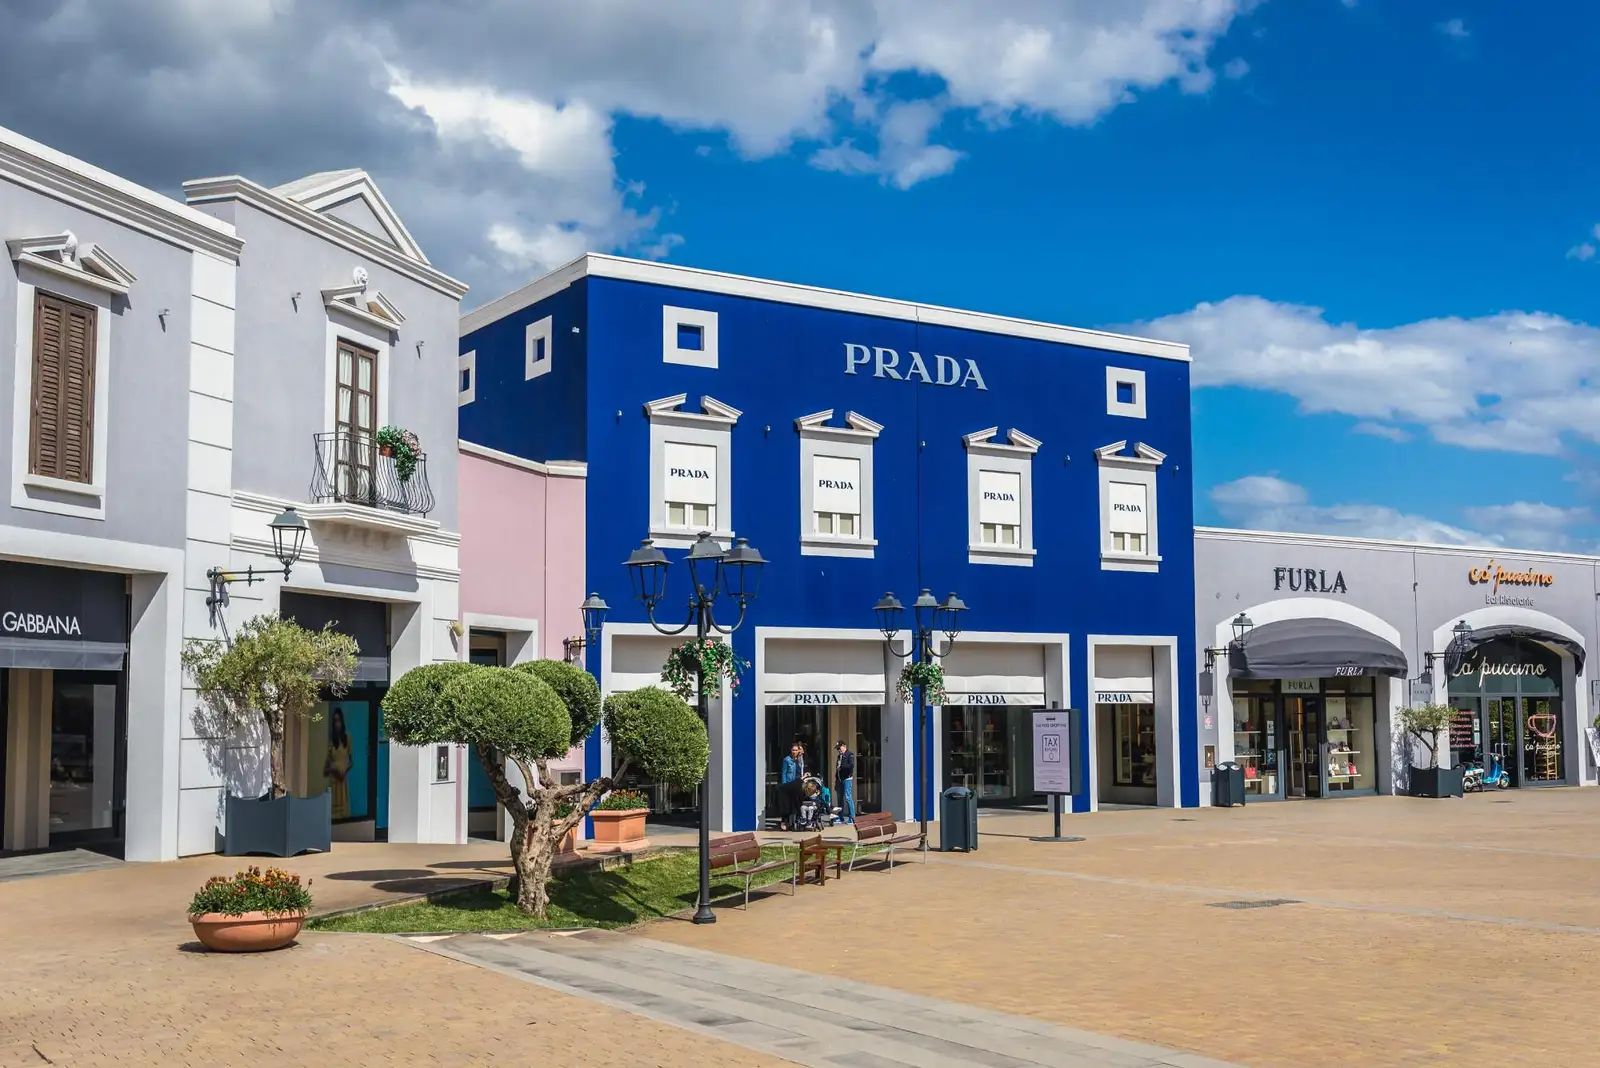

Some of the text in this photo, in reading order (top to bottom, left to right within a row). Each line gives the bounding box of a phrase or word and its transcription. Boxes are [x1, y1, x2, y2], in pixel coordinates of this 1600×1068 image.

[843, 342, 988, 391] PRADA
[670, 468, 709, 479] PRADA
[818, 479, 854, 490] PRADA
[983, 491, 1015, 502] PRADA
[1113, 503, 1142, 513] PRADA
[1273, 566, 1348, 594] FURLA
[2, 611, 82, 635] GABBANA
[1334, 666, 1364, 676] FURLA
[1287, 680, 1315, 690] FURLA
[794, 693, 839, 704] PRADA
[967, 694, 1007, 705] PRADA
[1097, 693, 1133, 702] PRADA
[1044, 737, 1058, 747] TAX
